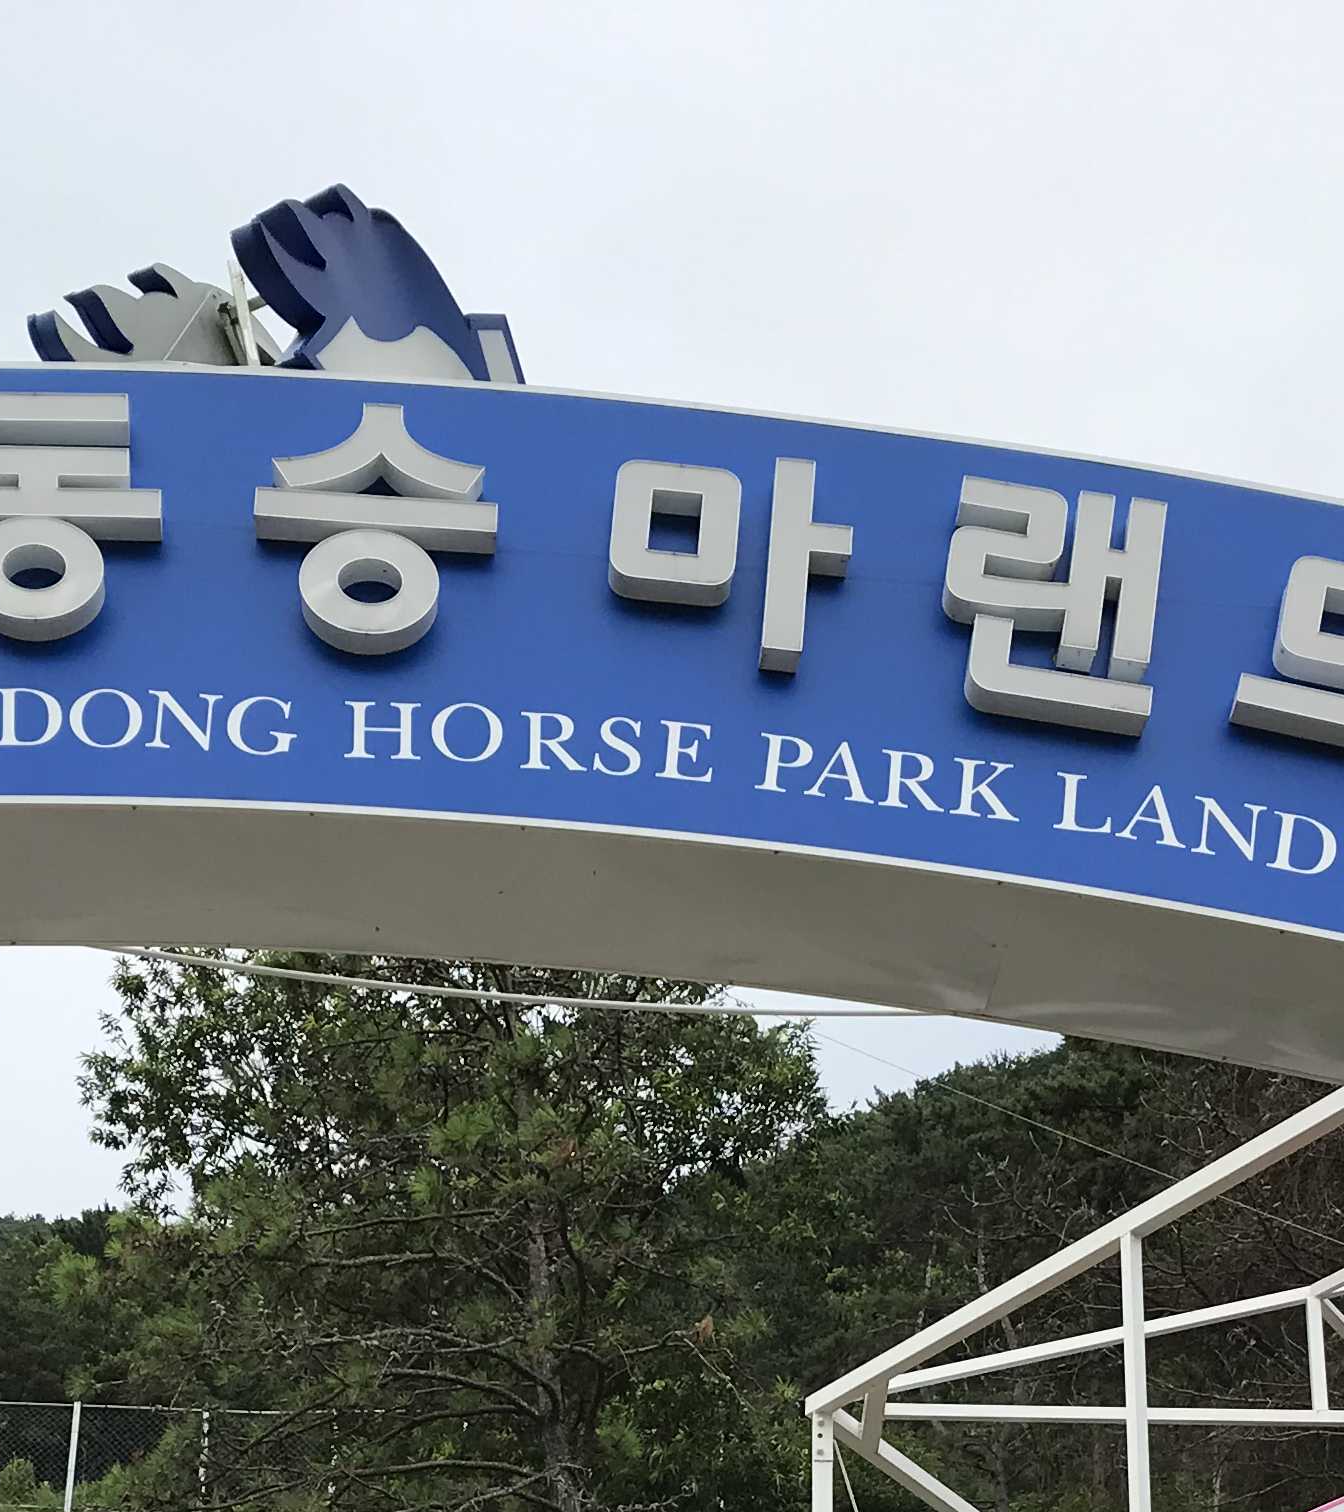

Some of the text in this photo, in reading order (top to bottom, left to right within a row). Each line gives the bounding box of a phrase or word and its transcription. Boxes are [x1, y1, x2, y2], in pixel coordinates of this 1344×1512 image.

[342, 699, 715, 784] HORSE
[753, 731, 1020, 823] PARK
[1053, 771, 1339, 877] LAND
